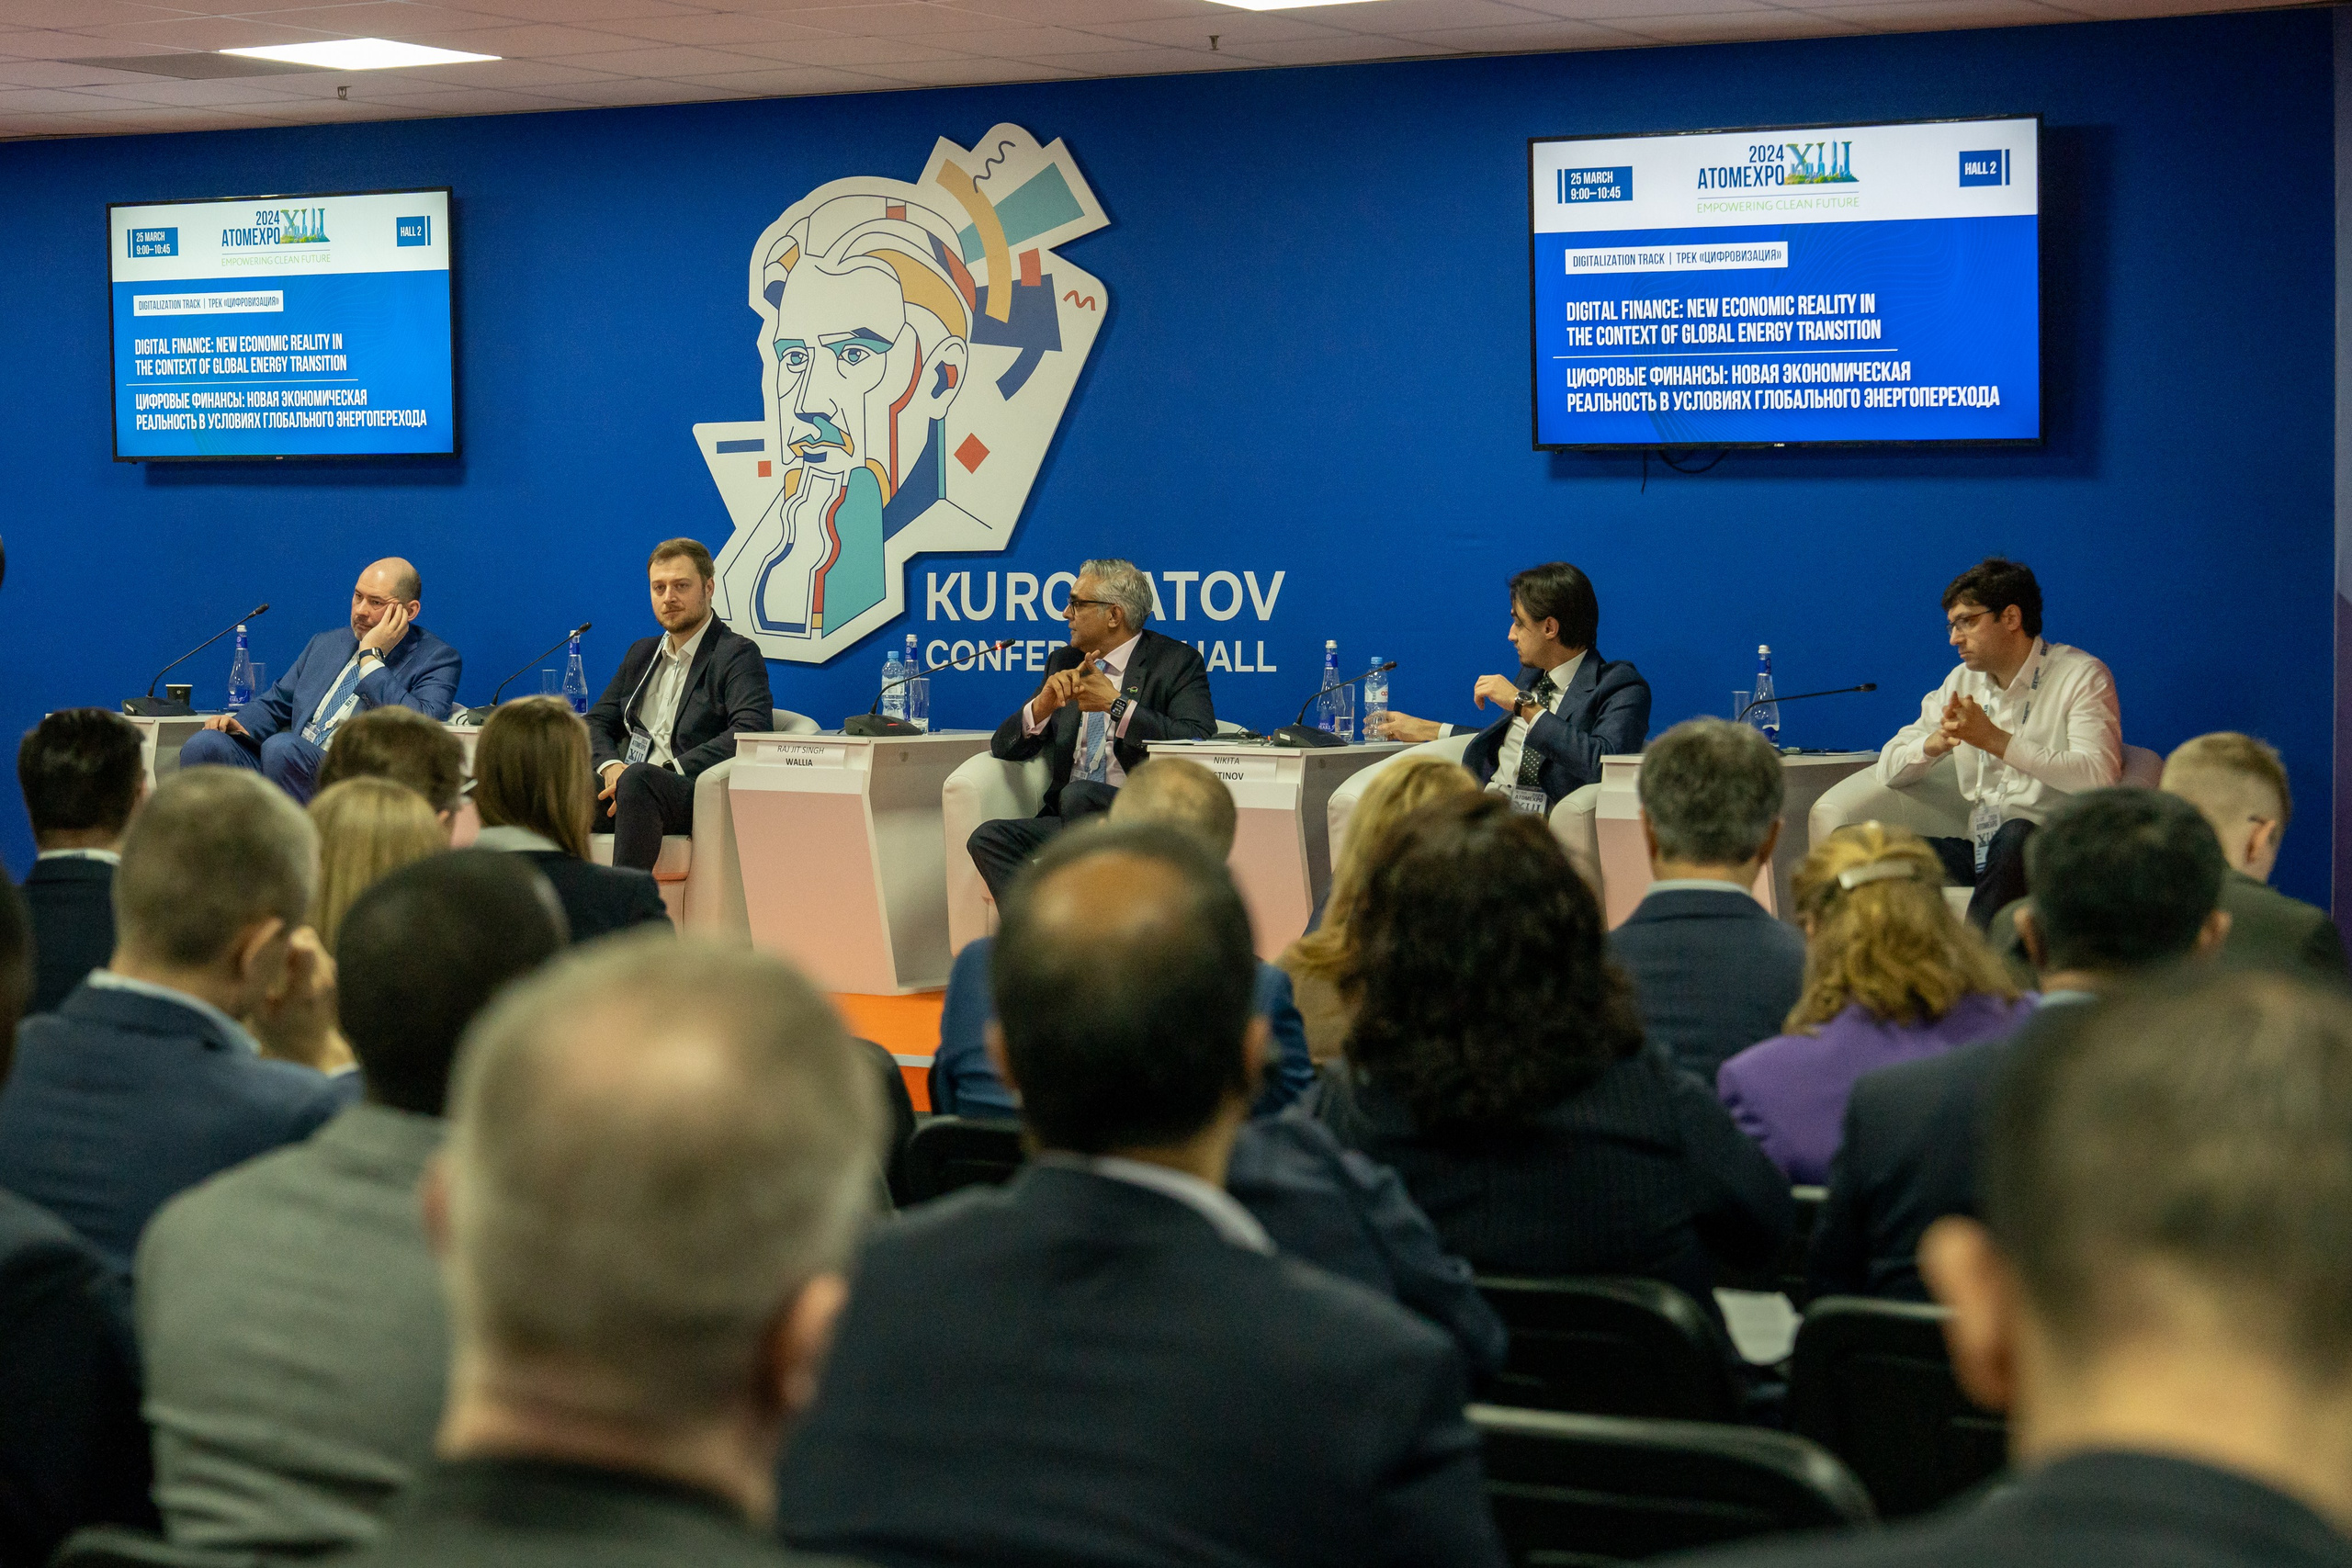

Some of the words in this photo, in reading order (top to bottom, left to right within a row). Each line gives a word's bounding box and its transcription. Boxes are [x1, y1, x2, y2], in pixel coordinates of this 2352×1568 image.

[1749, 145, 1784, 163] 2024
[1964, 162, 1988, 175] HALL
[1990, 161, 1996, 174] 2
[1571, 173, 1581, 185] 25
[1583, 171, 1613, 184] MARCH
[1698, 164, 1784, 189] ATOMEXPO
[1697, 200, 1773, 213] EMPOWERING
[1775, 198, 1812, 210] CLEAN
[1815, 197, 1860, 209] FUTURE
[255, 210, 279, 226] 2024
[136, 231, 143, 242] 25
[145, 231, 165, 242] MARCH
[221, 227, 280, 246] ATOMEXPO
[401, 226, 416, 237] HALL
[417, 226, 422, 236] 2
[221, 256, 273, 266] EMPOWERING
[274, 255, 300, 265] CLEAN
[301, 254, 331, 264] FUTURE
[1573, 254, 1635, 267] DIGITALIZATION
[1638, 253, 1665, 265] TRACK
[1676, 252, 1697, 264] ТРЕК
[1700, 250, 1781, 265] «ЦИФРОВИЗАЦИЯ»
[139, 299, 181, 310] DIGITALIZATION
[183, 299, 200, 309] TRACK
[209, 298, 222, 309] ТРЕК
[224, 297, 279, 309] «ЦИФРОВИЗАЦИЯ»
[1566, 301, 1618, 321] DIGITAL
[1622, 299, 1683, 320] FINANCE:
[1687, 299, 1718, 319] NEW
[1722, 296, 1794, 318] ECONOMIC
[1798, 294, 1857, 315] REALITY
[1860, 293, 1875, 313] IN
[1566, 327, 1592, 346] THE
[1596, 325, 1657, 345] CONTEXT
[1661, 324, 1679, 344] OF
[1681, 323, 1735, 344] GLOBAL
[1738, 321, 1793, 342] ENERGY
[1796, 320, 1882, 342] TRANSITION
[134, 338, 170, 355] DIGITAL
[172, 337, 213, 354] FINANCE:
[216, 336, 237, 353] NEW
[240, 334, 288, 352] ECONOMIC
[290, 333, 330, 351] REALITY
[333, 333, 343, 349] IN
[135, 359, 153, 375] THE
[155, 358, 197, 375] CONTEXT
[199, 358, 211, 374] OF
[213, 357, 249, 374] GLOBAL
[251, 356, 288, 373] ENERGY
[290, 355, 346, 372] TRANSITION
[1566, 367, 1646, 389] ЦИФРОВЫЕ
[1649, 366, 1728, 386] ФИНАНСЫ:
[1732, 364, 1779, 384] НОВАЯ
[1783, 361, 1911, 384] ЭКОНОМИЧЕСКАЯ
[136, 393, 190, 411] ЦИФРОВЫЕ
[191, 392, 244, 408] ФИНАНСЫ:
[247, 391, 279, 408] НОВАЯ
[281, 389, 368, 407] ЭКОНОМИЧЕСКАЯ
[1567, 391, 1657, 412] РЕАЛЬНОСТЬ
[1659, 391, 1669, 411] В
[1672, 390, 1752, 412] УСЛОВИЯХ
[1755, 388, 1860, 410] ГЛОБАЛЬНОГО
[1864, 386, 2000, 408] ЭНЕРГОПЕРЕХОДА
[137, 413, 197, 430] РЕАЛЬНОСТЬ
[199, 413, 206, 429] В
[208, 412, 261, 430] УСЛОВИЯХ
[263, 412, 334, 428] ГЛОБАЛЬНОГО
[336, 410, 427, 427] ЭНЕРГОПЕРЕХОДА
[777, 745, 790, 753] RAJ
[802, 746, 825, 754] SINGH
